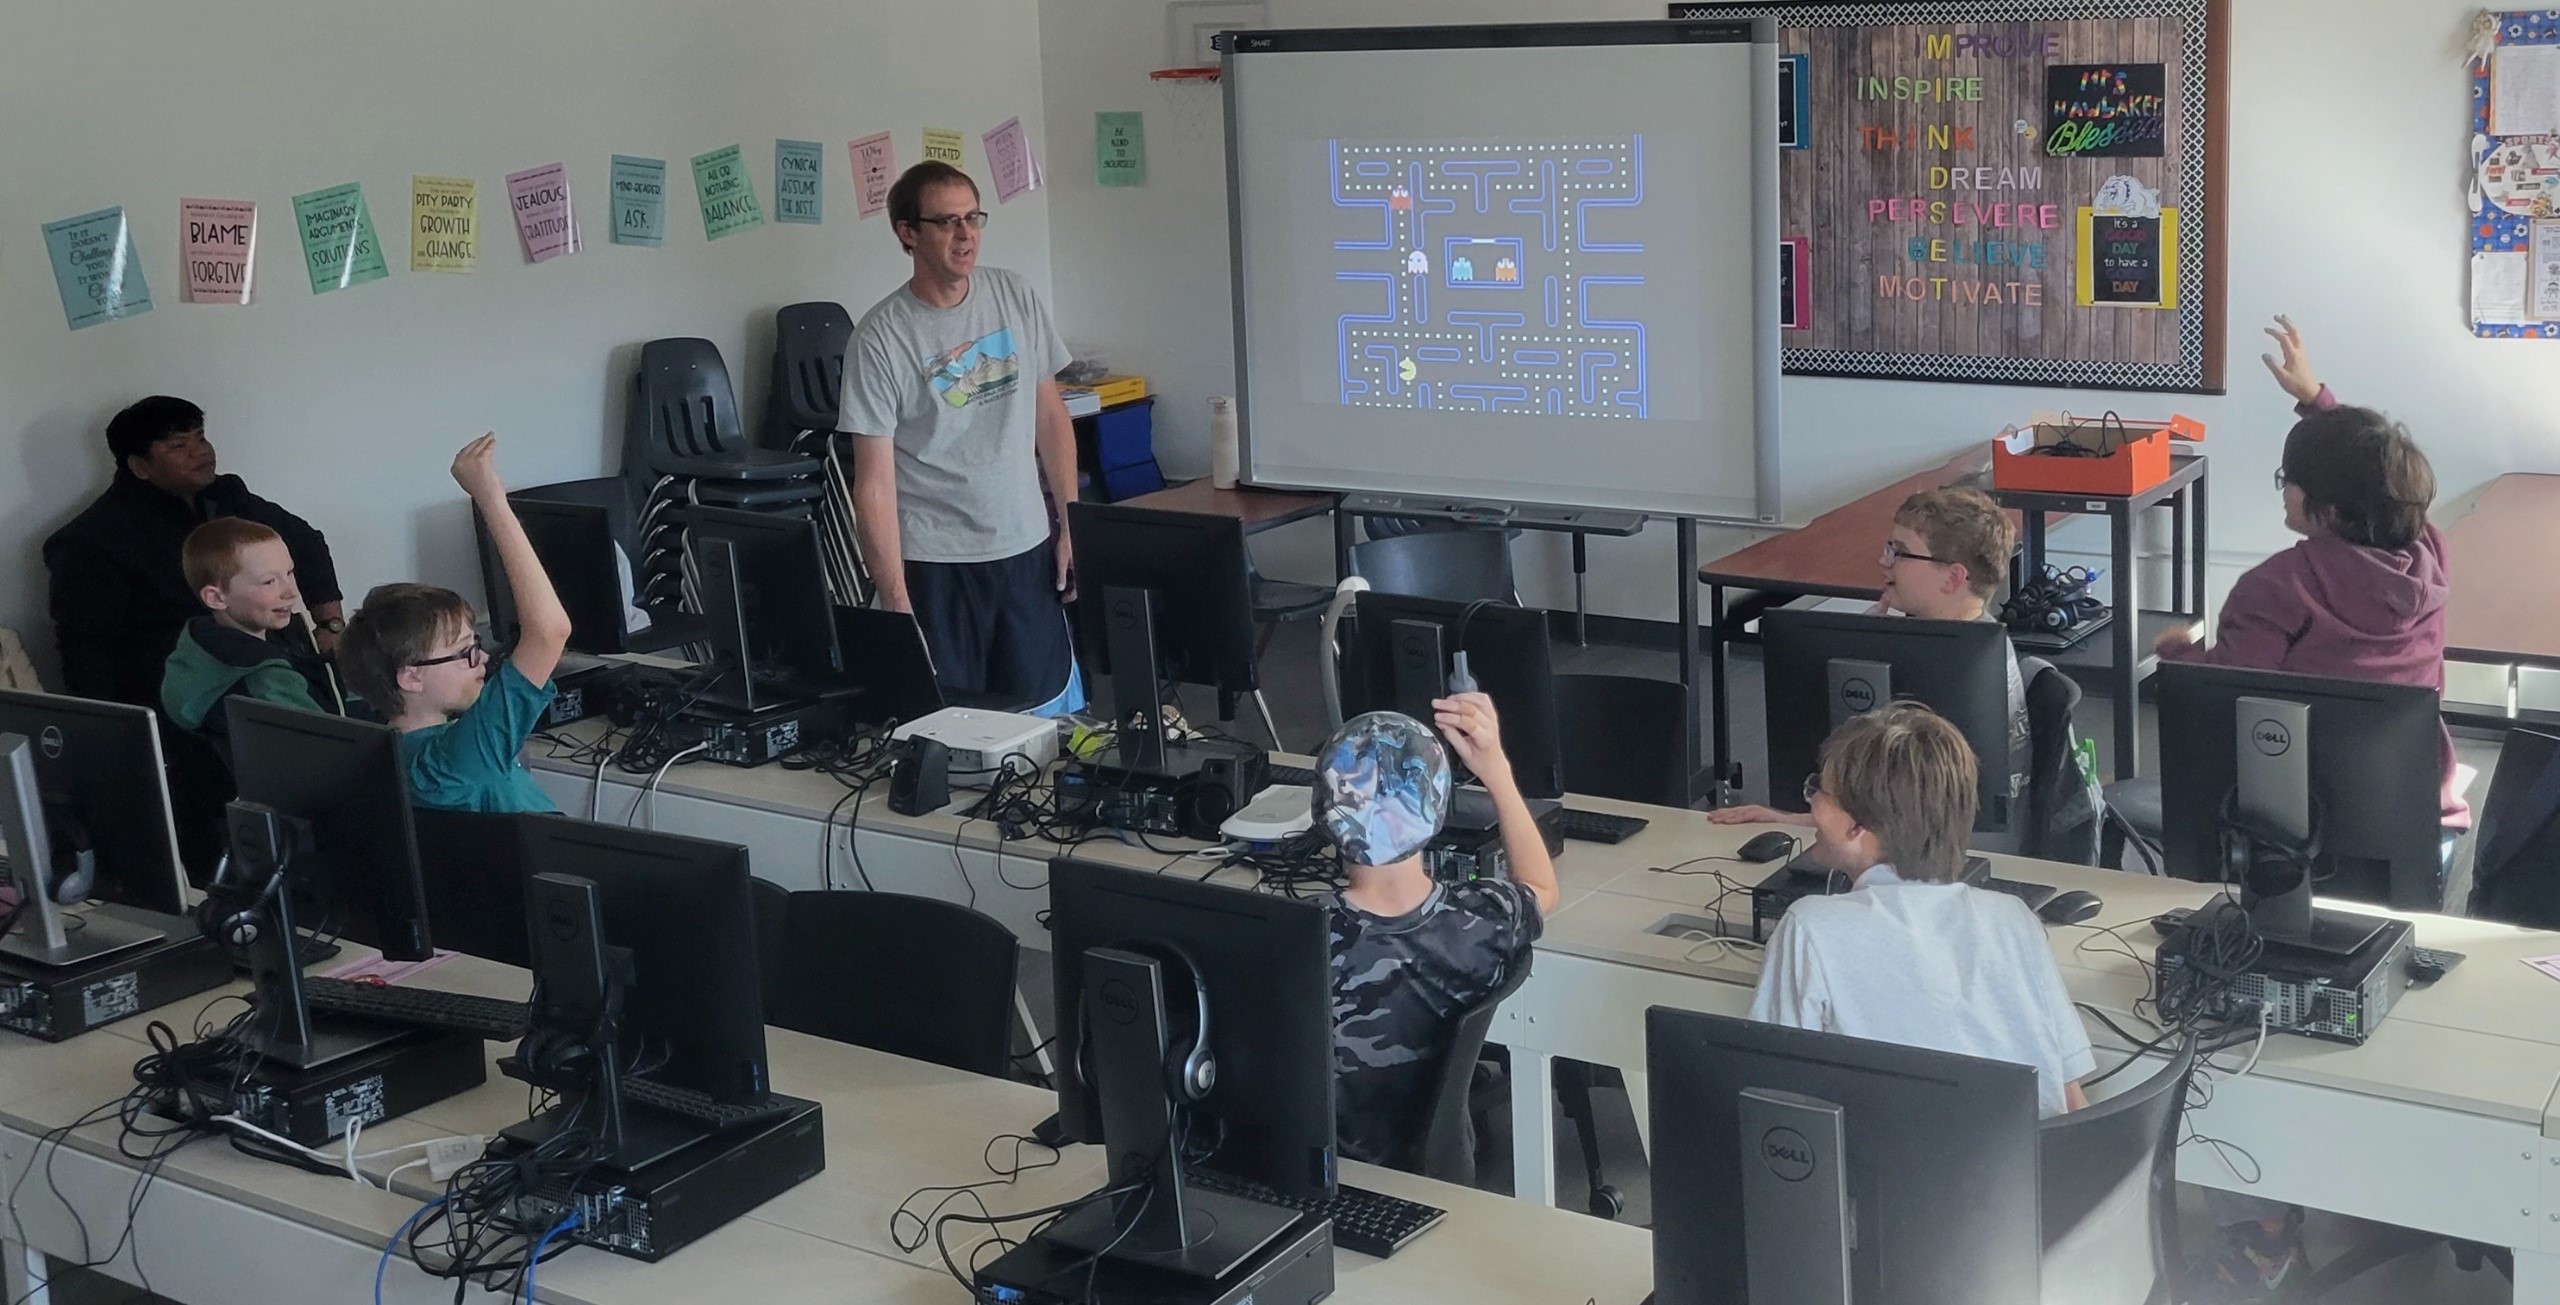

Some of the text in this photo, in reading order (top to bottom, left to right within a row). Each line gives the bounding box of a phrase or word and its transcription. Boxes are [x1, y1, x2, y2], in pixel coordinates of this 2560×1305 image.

[1914, 32, 2060, 60] IMPROVE
[1857, 76, 1984, 104] INSPIRE
[1858, 124, 1975, 152] THINK
[925, 145, 960, 160] DEFEATED
[781, 179, 815, 195] ASSUME
[1928, 166, 2042, 191] DREAM
[416, 193, 473, 209] PITY PARTY
[305, 204, 356, 227] IMAGINARY
[420, 214, 470, 236] GROWTH
[624, 208, 650, 229] ASK.
[1868, 198, 2061, 230] PERSEVERE
[190, 222, 249, 246] BLAME
[309, 218, 364, 240] ARGUMENTS
[1908, 235, 2049, 270] BELIEVE
[2111, 242, 2139, 255] DAY
[2104, 257, 2115, 267] to
[2118, 257, 2139, 268] have
[1879, 275, 2043, 307] MOTIVATE
[2112, 281, 2140, 293] DAY
[1845, 689, 1872, 700] DELL
[2256, 731, 2287, 744] DELL
[1768, 1144, 1810, 1165] DELL
